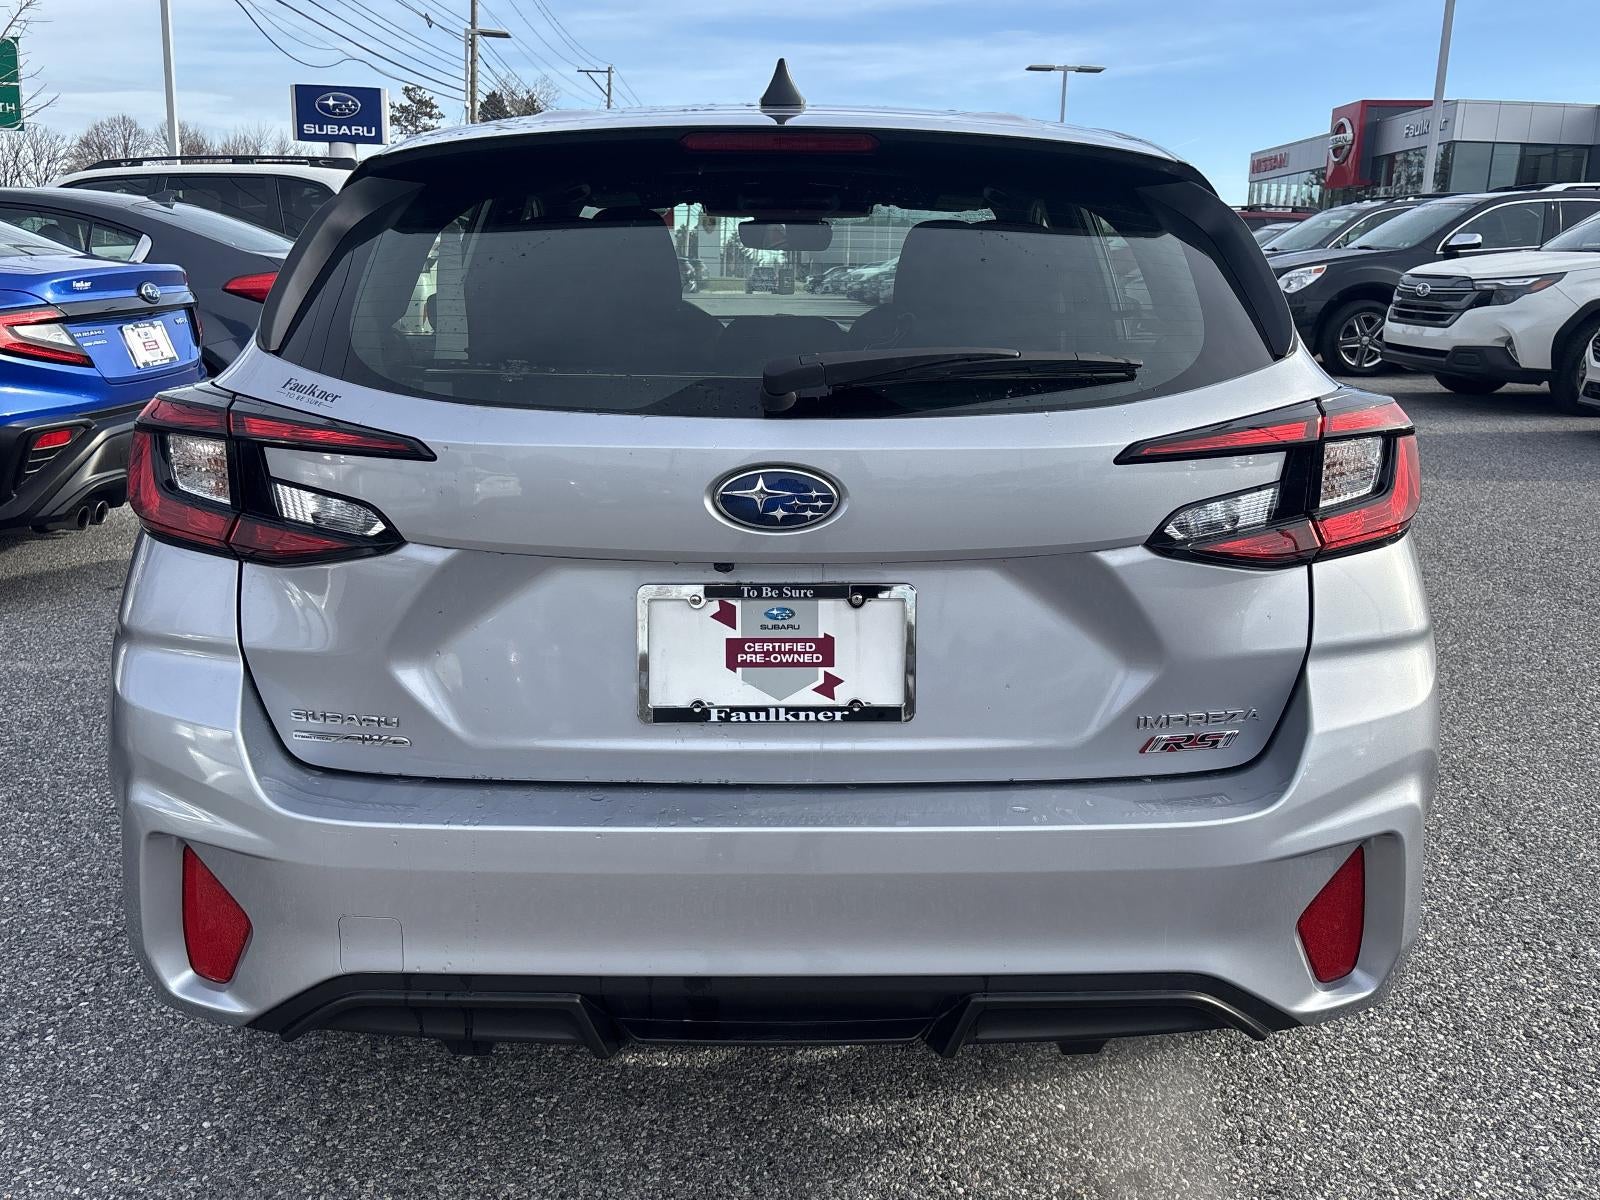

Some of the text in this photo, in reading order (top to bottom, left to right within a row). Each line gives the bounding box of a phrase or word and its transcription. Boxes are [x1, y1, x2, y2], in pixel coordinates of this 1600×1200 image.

[303, 123, 376, 137] SUBARU
[1403, 118, 1449, 138] Faulkr
[1251, 151, 1288, 175] NISSAN
[281, 377, 342, 403] Faulkner
[284, 391, 296, 399] TO
[305, 397, 324, 407] SURE
[740, 586, 814, 598] To Be Sure
[759, 623, 801, 631] SUBARU
[744, 642, 816, 652] CERTIFIED
[737, 653, 823, 663] PRE-OWNED
[290, 709, 400, 729] SUBARU
[708, 707, 850, 722] Faulkner
[1137, 706, 1260, 730] IMPREZA
[335, 733, 412, 747] AWD
[1150, 730, 1231, 753] RS
